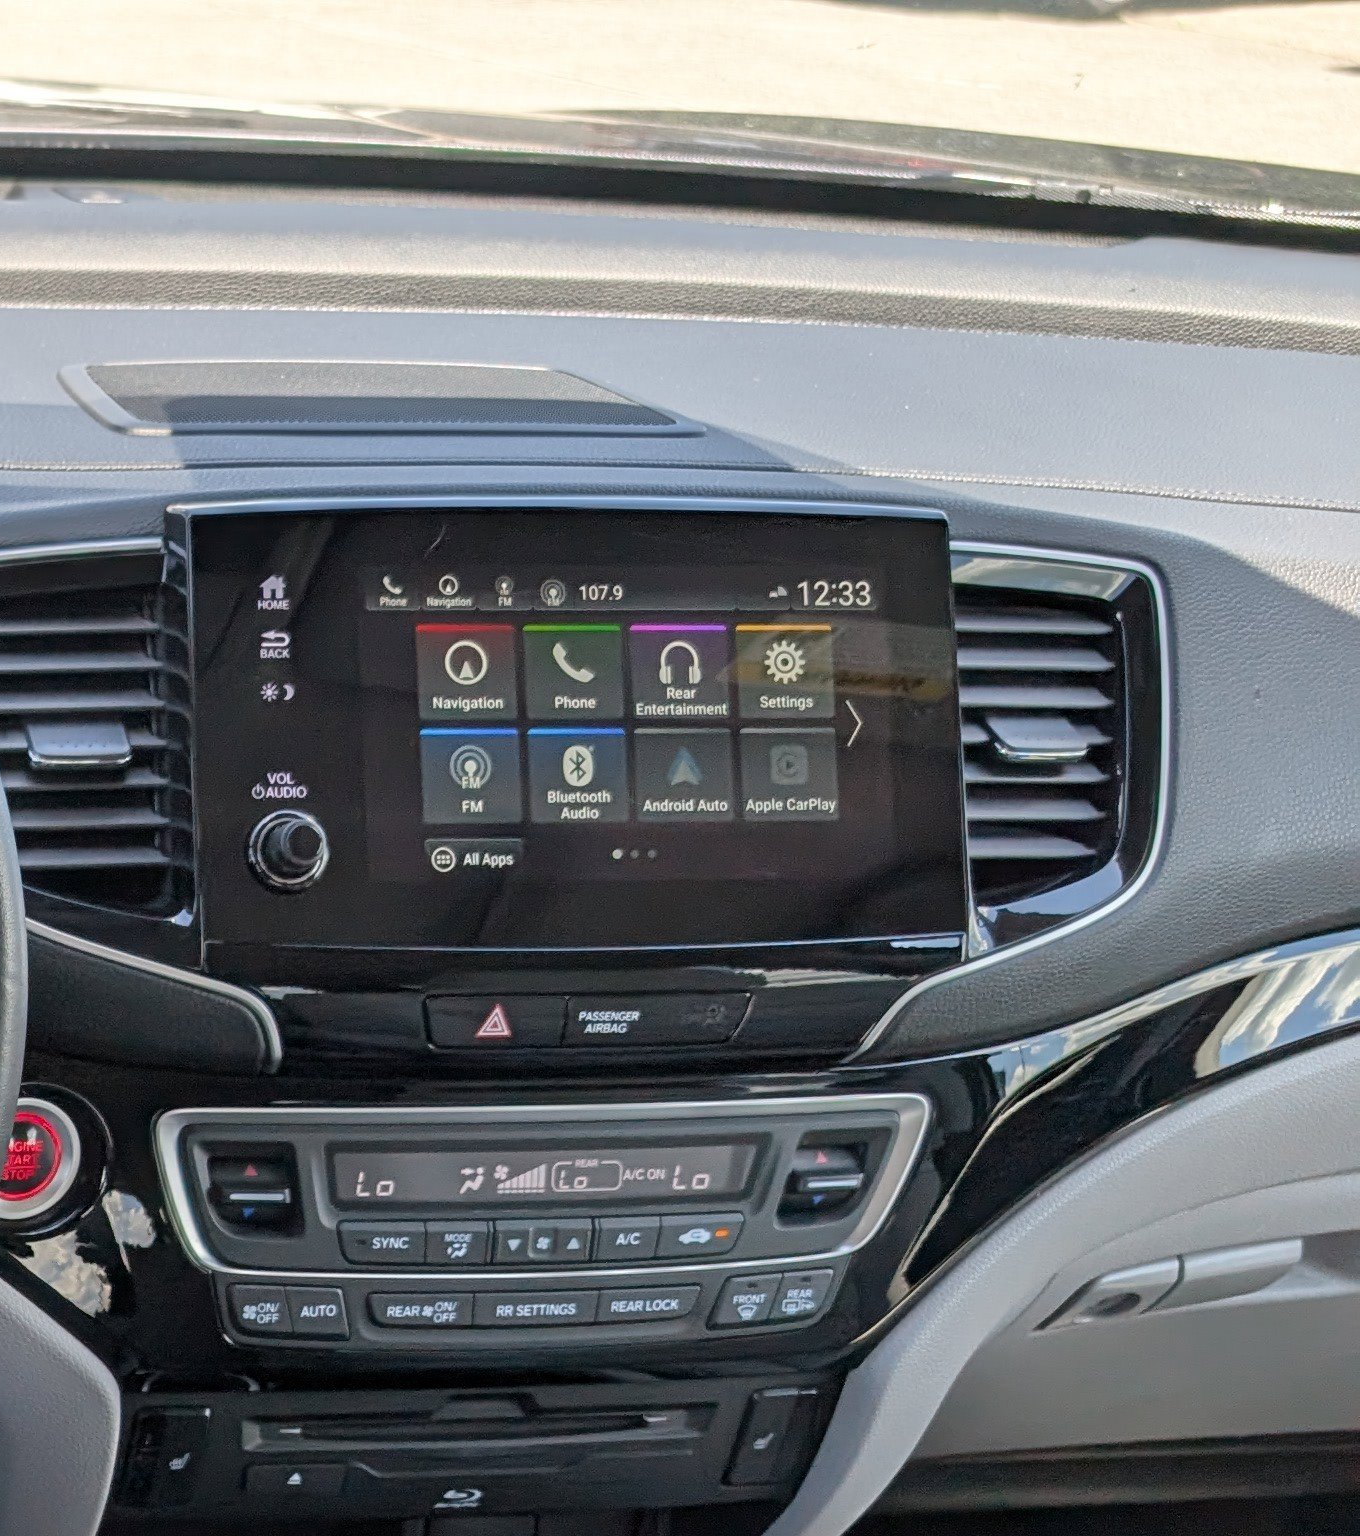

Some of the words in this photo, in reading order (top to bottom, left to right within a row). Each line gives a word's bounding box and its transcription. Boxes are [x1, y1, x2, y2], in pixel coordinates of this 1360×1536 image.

[579, 585, 623, 601] 107.9
[797, 581, 872, 606] 12:33
[258, 600, 290, 610] HOME
[380, 597, 407, 606] Phone
[427, 597, 472, 608] Navigation
[498, 597, 512, 606] FM
[259, 649, 290, 659] BACK
[666, 686, 697, 700] Rear
[432, 696, 504, 711] Navigation
[554, 696, 596, 709] Phone
[760, 696, 813, 711] Settings
[635, 702, 728, 716] Entertainment
[267, 773, 295, 785] VOL
[461, 776, 481, 789] FM
[266, 786, 307, 798] AUDIO
[547, 789, 611, 803] Bluetooth
[462, 801, 483, 813] FM
[643, 799, 693, 812] Android
[697, 799, 728, 812] Auto
[745, 799, 782, 814] Apple
[786, 798, 836, 814] CarPlay
[560, 806, 599, 820] Audio
[463, 853, 481, 866] All
[482, 853, 514, 869] Apps
[578, 1011, 641, 1022] PASSENGER
[584, 1023, 628, 1033] AIRBAG
[8, 1154, 40, 1165] TART
[575, 1159, 598, 1167] REAR
[623, 1169, 645, 1181] A/C
[647, 1168, 666, 1180] ON
[372, 1237, 410, 1249] SYNC
[444, 1233, 472, 1243] MODE
[616, 1232, 641, 1246] A/C
[733, 1293, 766, 1304] FRONT
[787, 1289, 813, 1299] REAR
[300, 1305, 337, 1317] AUTO
[386, 1306, 420, 1317] REAR
[496, 1305, 514, 1317] RR
[516, 1303, 576, 1316] SETTINGS
[611, 1300, 643, 1312] REAR
[645, 1299, 679, 1311] LOCK
[256, 1313, 279, 1323] OFF
[433, 1312, 456, 1322] OFF
